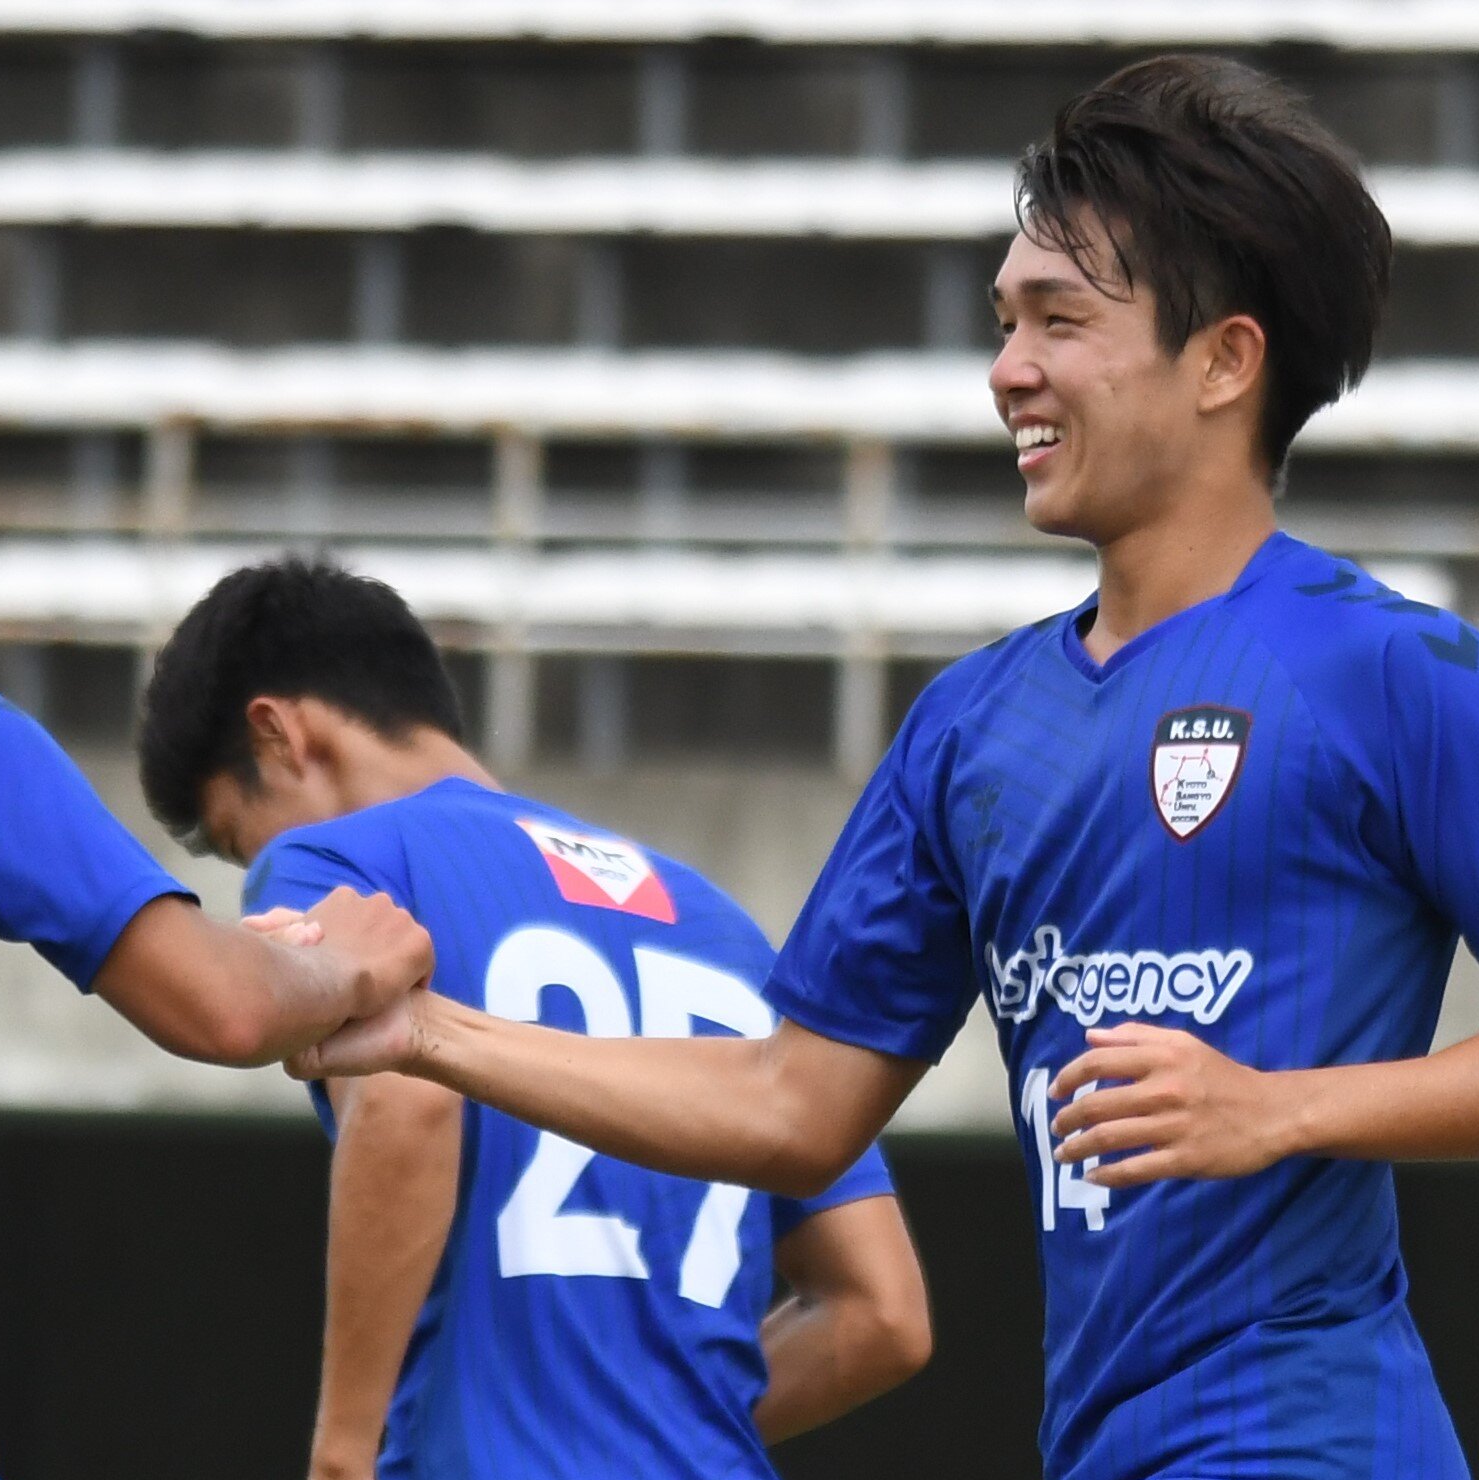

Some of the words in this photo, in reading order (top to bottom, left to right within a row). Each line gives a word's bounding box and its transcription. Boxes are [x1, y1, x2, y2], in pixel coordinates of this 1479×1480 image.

[1170, 719, 1235, 740] K.S.U.
[484, 928, 775, 1309] 27
[1021, 1068, 1110, 1232] 14
